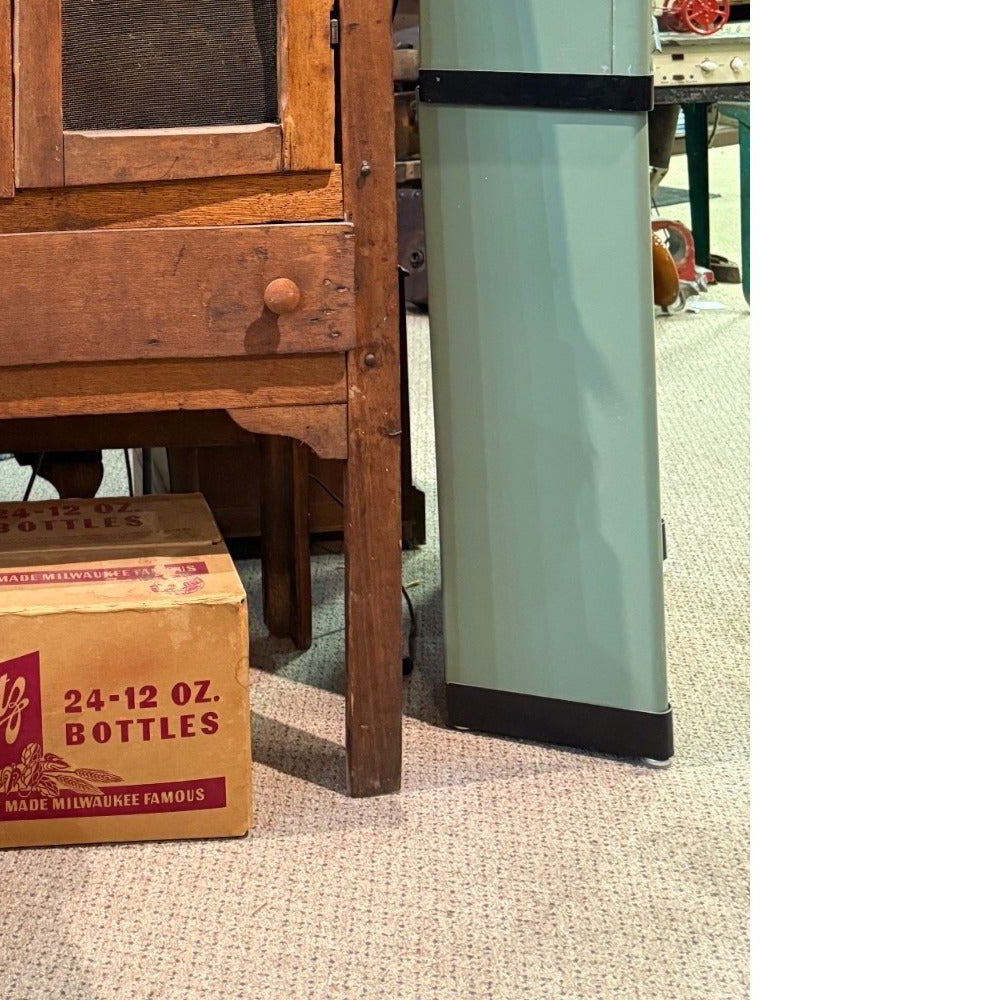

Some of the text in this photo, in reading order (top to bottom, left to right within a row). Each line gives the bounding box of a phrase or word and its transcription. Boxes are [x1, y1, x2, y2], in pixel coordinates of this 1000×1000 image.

[41, 570, 130, 583] MILWAUKEE
[64, 679, 221, 713] 24-12 OZ.
[65, 712, 220, 746] BOTTLES
[5, 797, 48, 812] MADE
[53, 793, 140, 811] MILWAUKEE
[144, 787, 206, 805] FAMOUS
